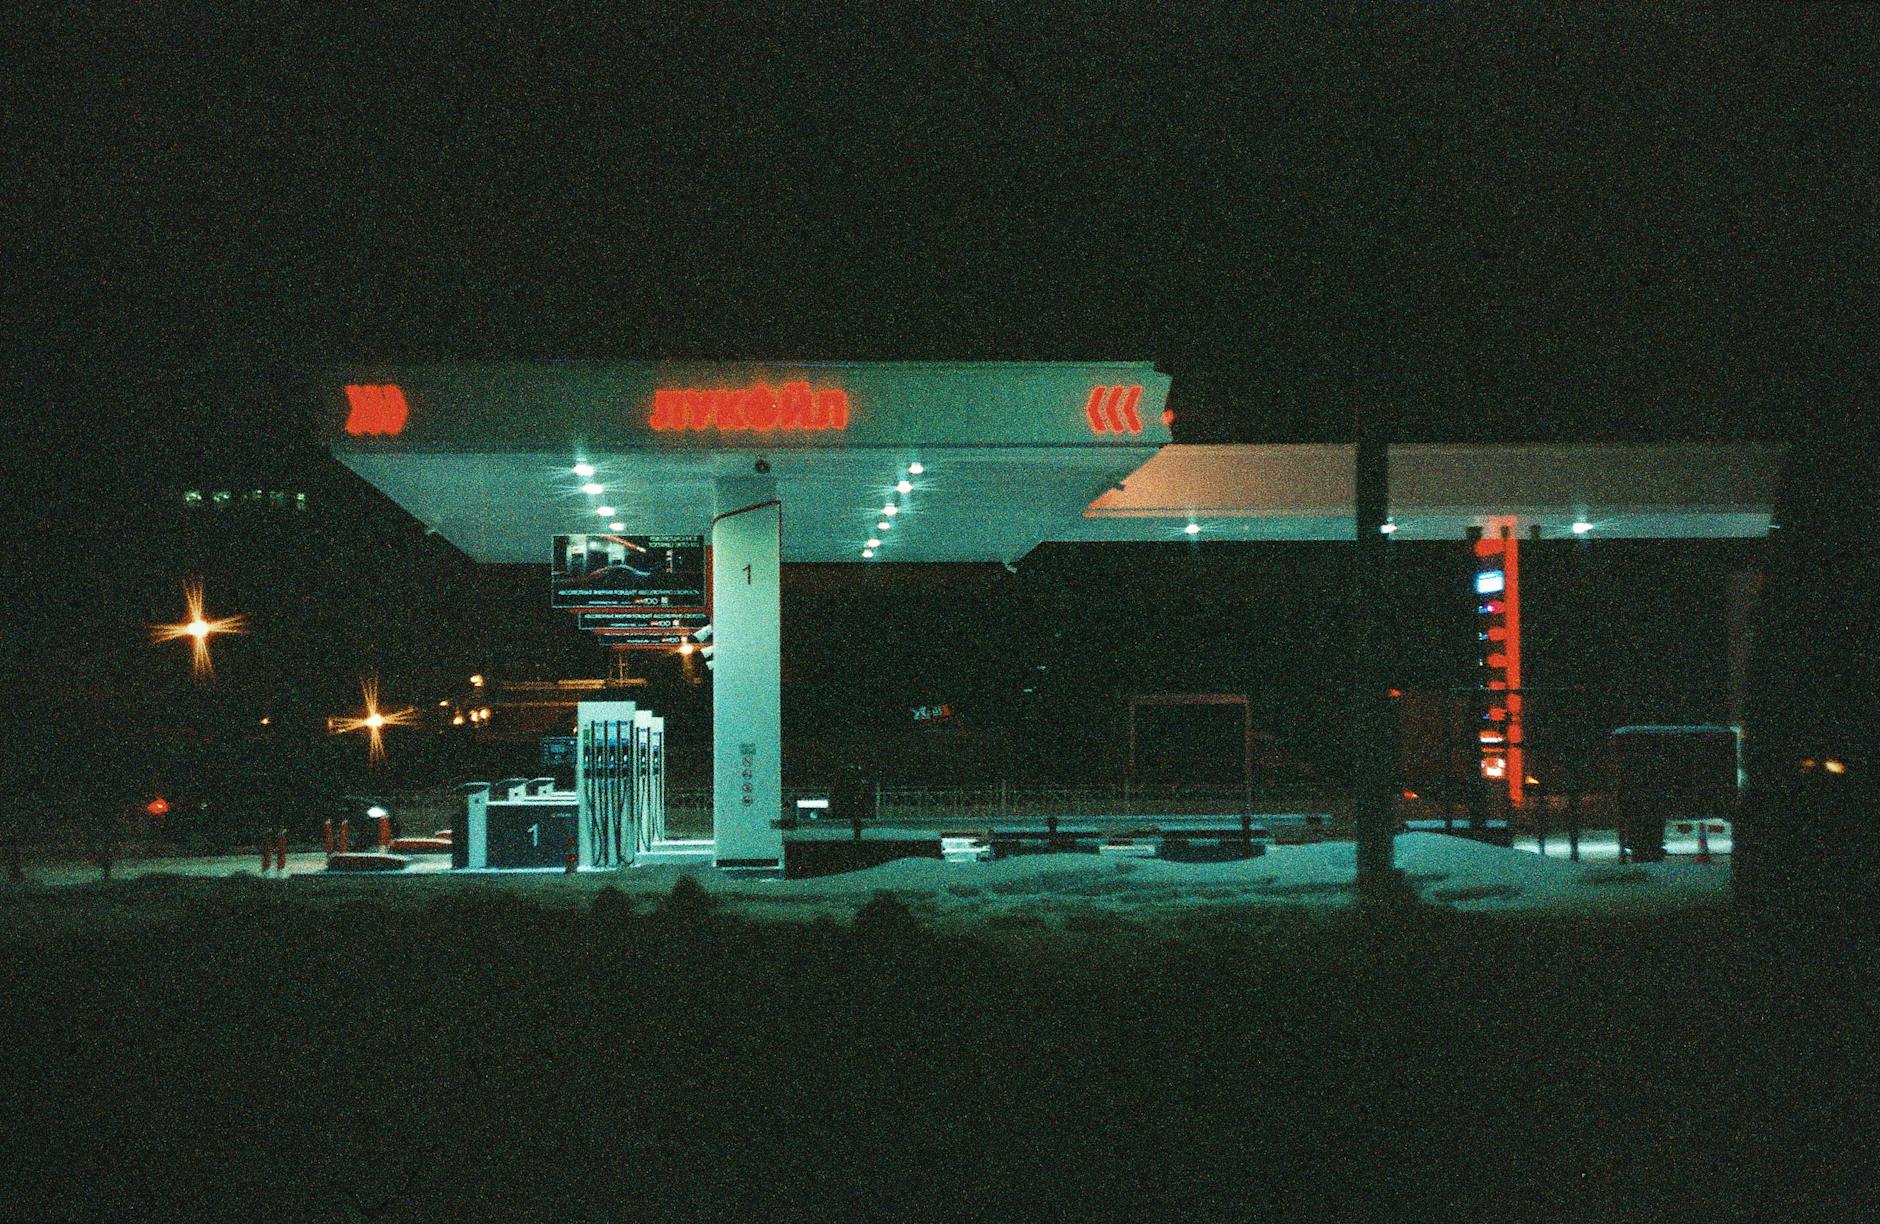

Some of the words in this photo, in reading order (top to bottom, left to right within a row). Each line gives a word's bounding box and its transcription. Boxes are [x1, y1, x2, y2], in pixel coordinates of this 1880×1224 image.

[650, 382, 848, 430] ЛУКОЙЛ
[742, 564, 752, 585] 1
[527, 823, 539, 847] 1
